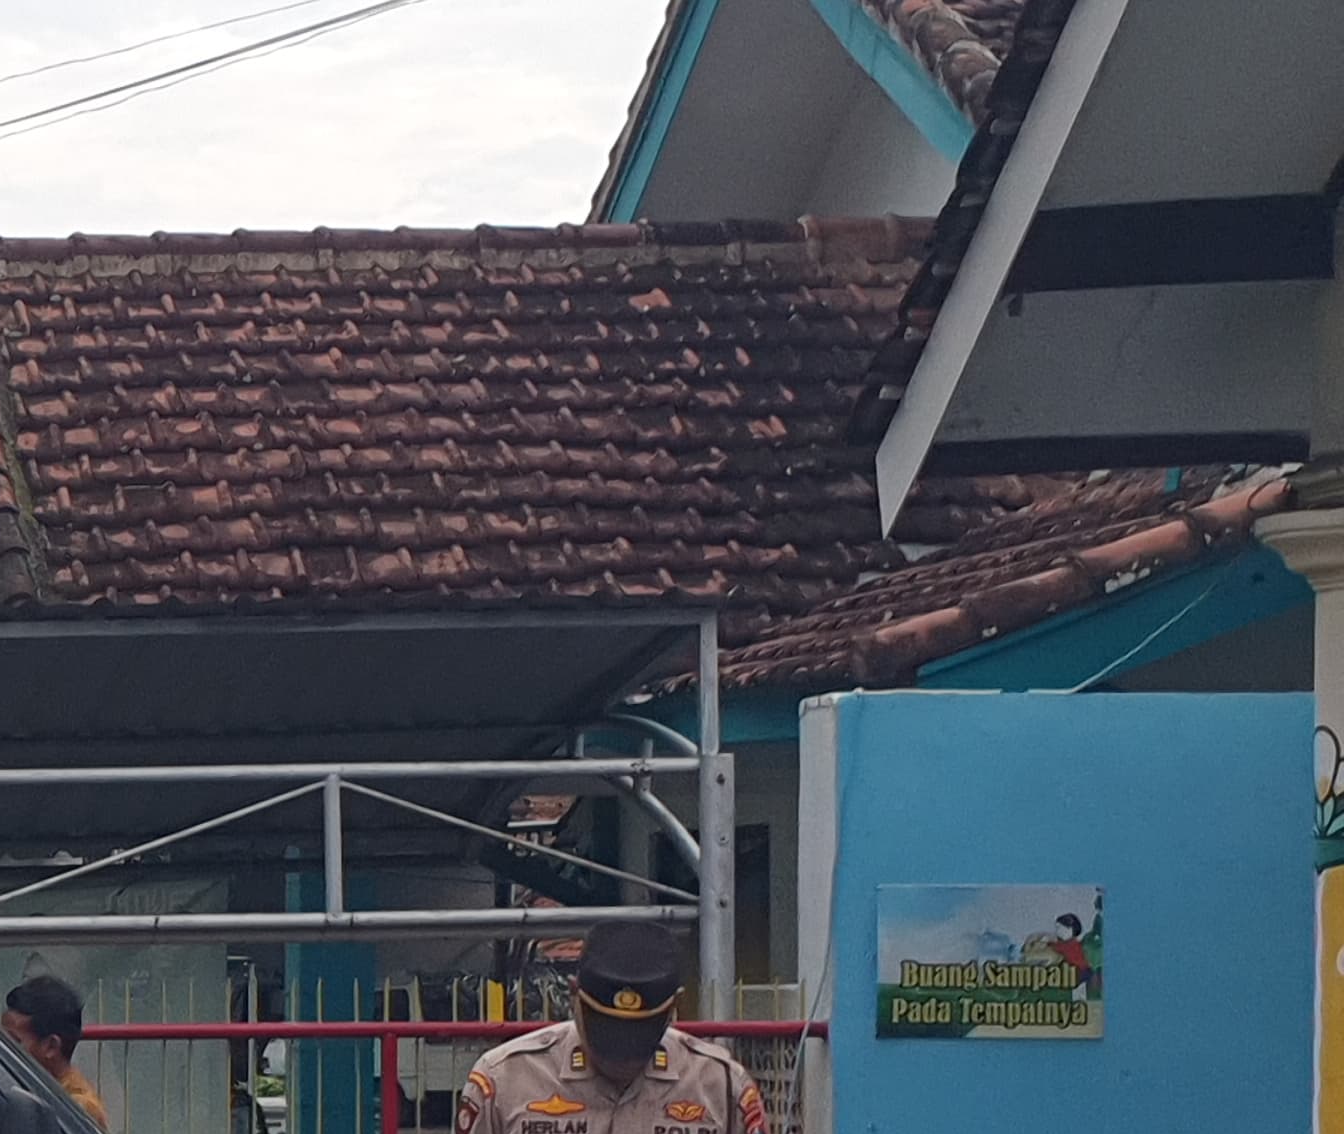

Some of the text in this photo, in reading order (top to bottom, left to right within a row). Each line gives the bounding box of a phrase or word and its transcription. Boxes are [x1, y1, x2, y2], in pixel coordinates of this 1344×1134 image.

[900, 960, 1079, 991] Buang Sampah
[891, 997, 1089, 1030] Pada Tempatnya
